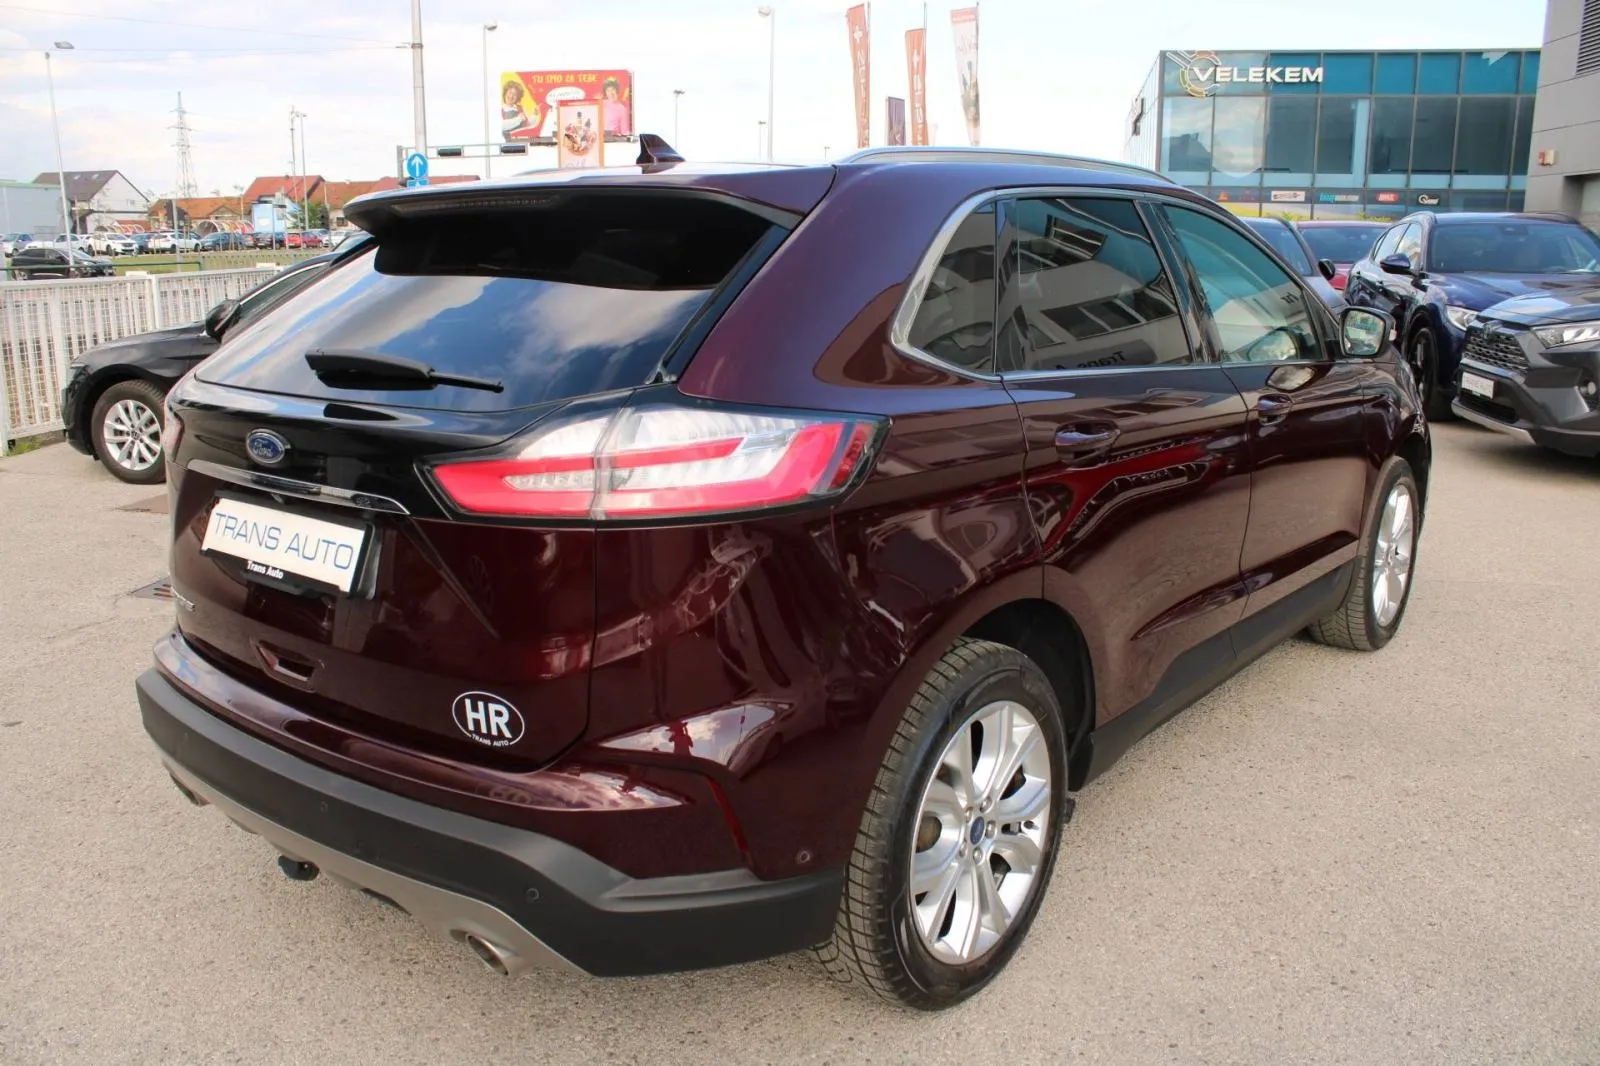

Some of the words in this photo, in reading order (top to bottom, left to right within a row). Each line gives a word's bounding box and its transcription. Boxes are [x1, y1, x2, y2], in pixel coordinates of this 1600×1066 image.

[1192, 66, 1324, 83] VELEKEM
[215, 512, 282, 551] TRANS
[285, 532, 354, 570] AUTO
[246, 560, 267, 576] Trans
[267, 565, 284, 580] Auto
[464, 697, 513, 739] HR
[470, 733, 492, 746] TRANS
